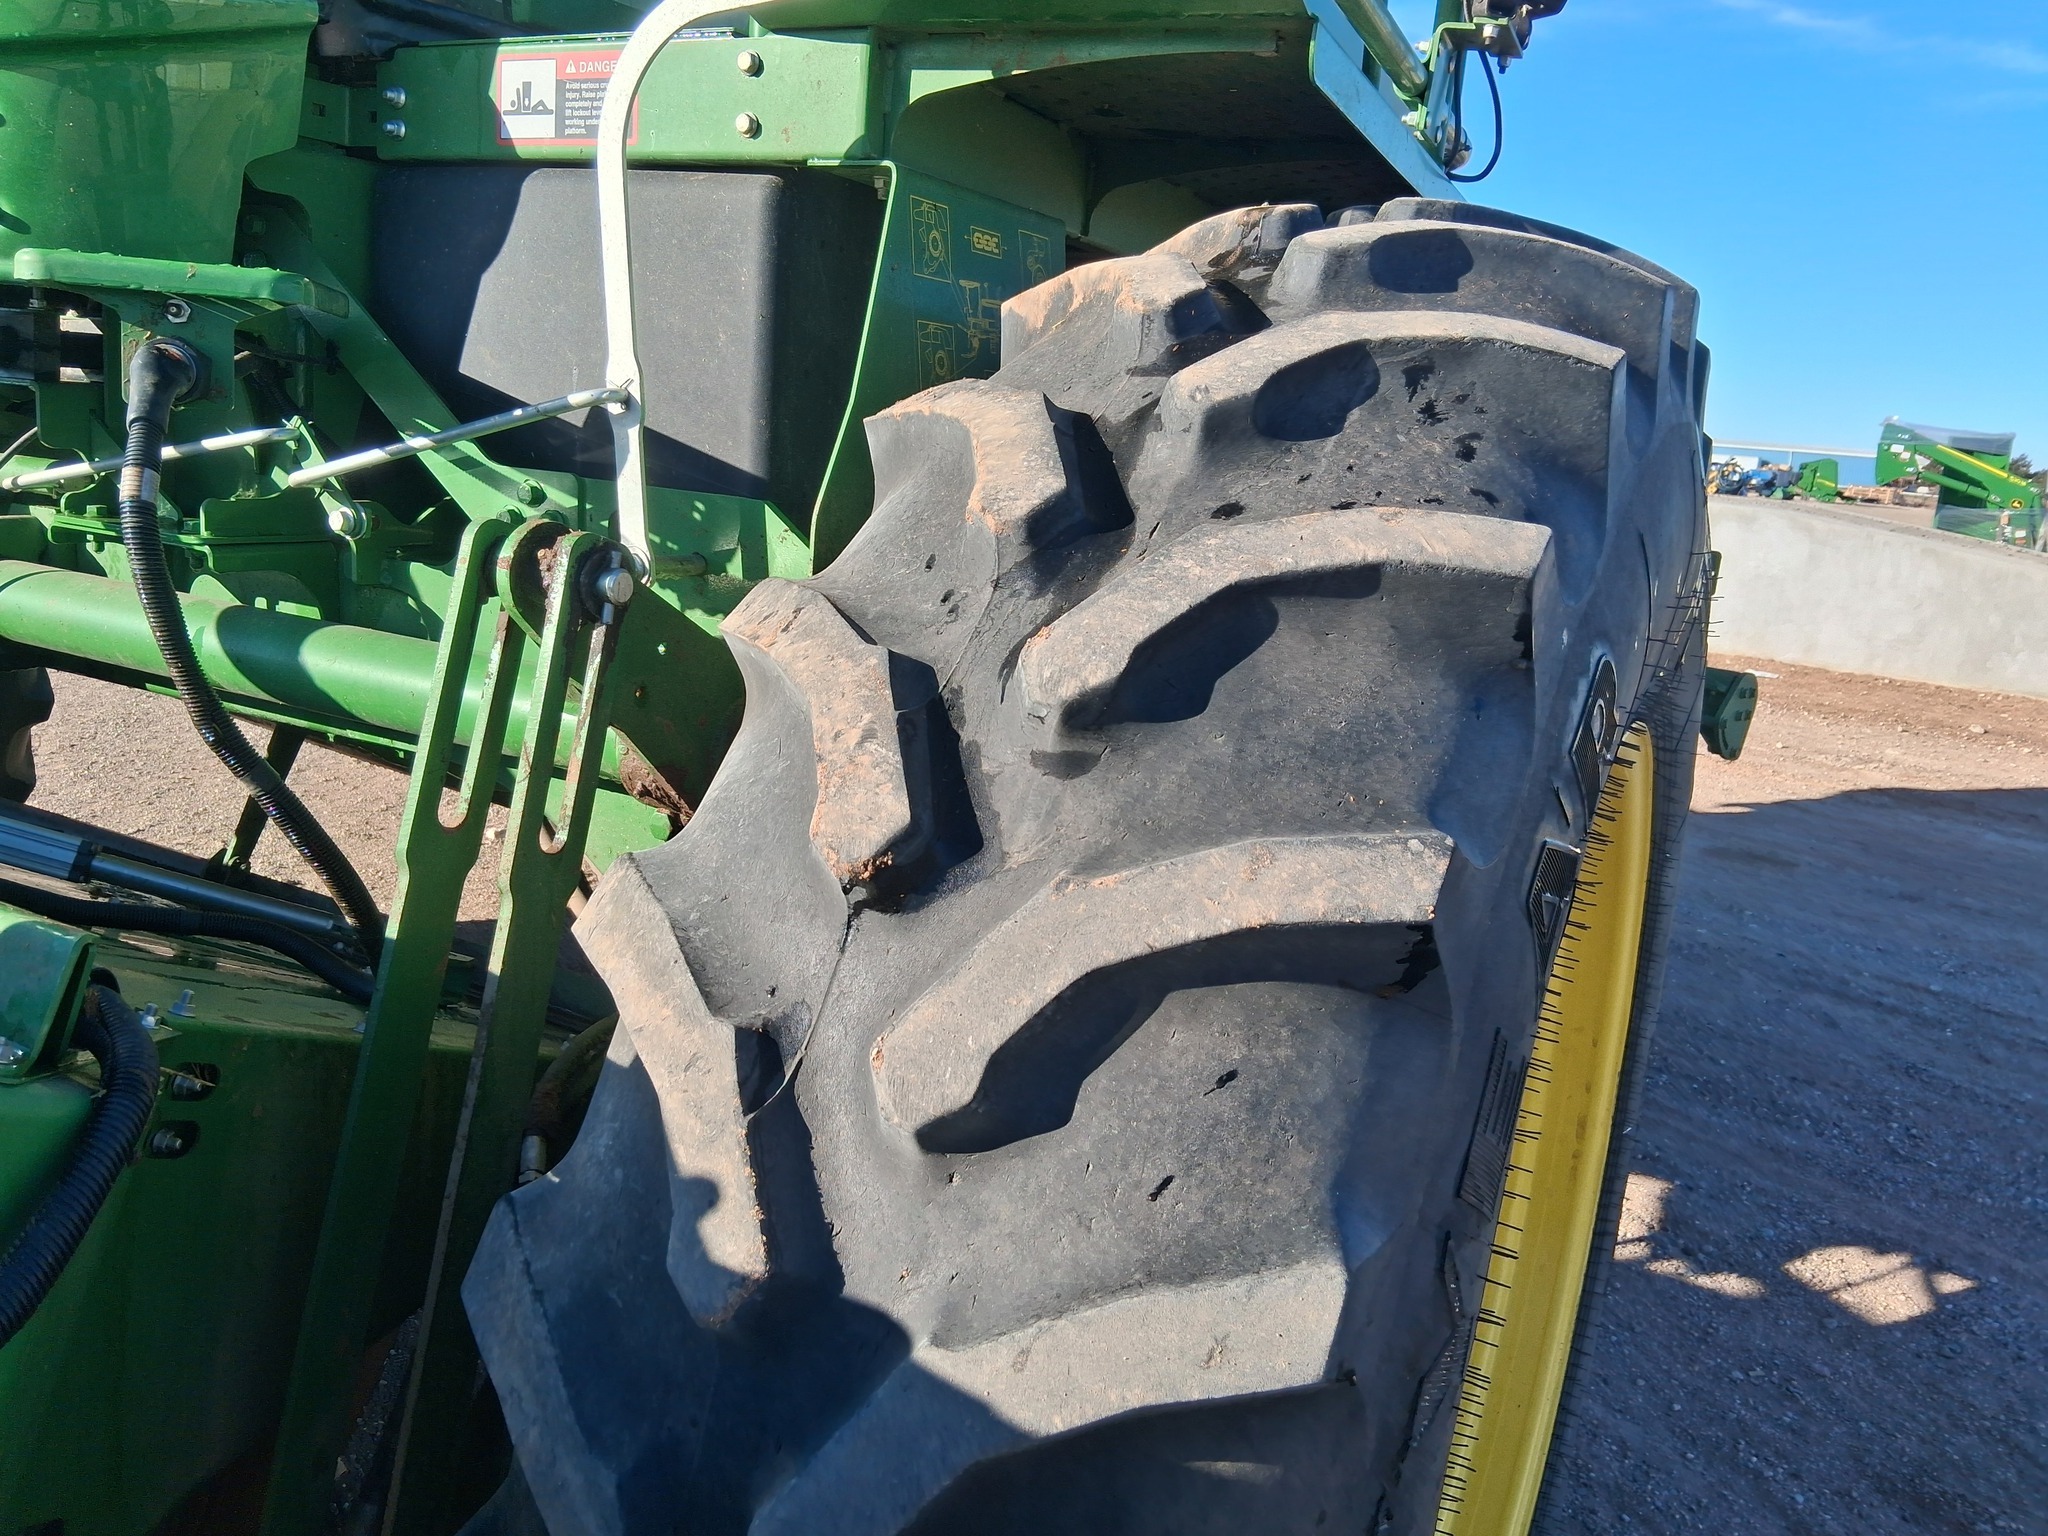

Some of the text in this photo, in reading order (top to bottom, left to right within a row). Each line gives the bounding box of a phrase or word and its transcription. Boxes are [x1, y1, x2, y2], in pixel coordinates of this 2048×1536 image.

[580, 61, 617, 72] DANGE
[581, 81, 599, 89] serious
[565, 100, 592, 108] completely
[565, 118, 584, 127] working
